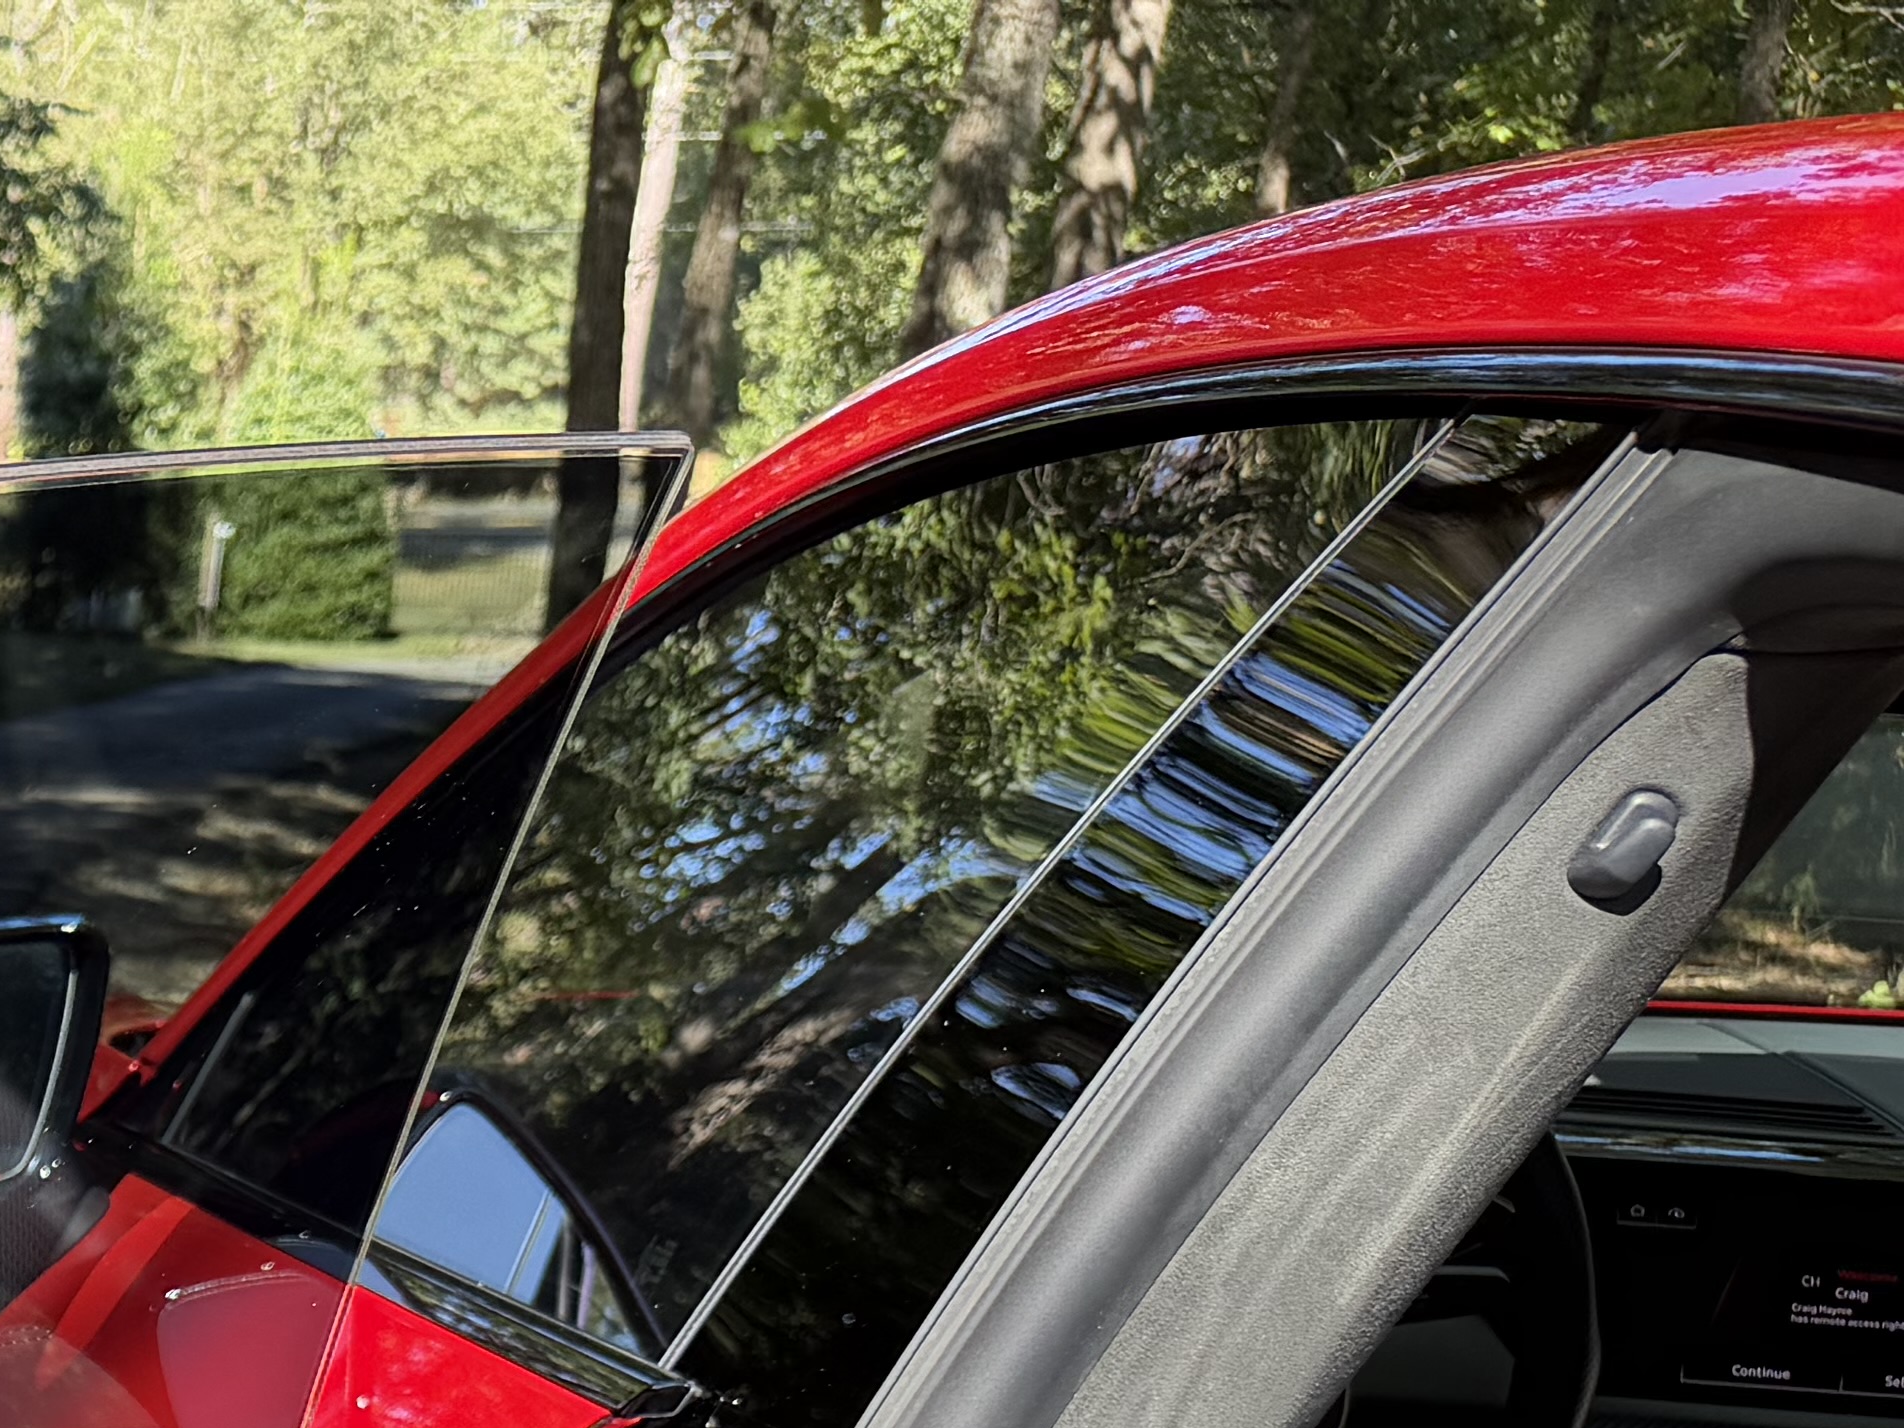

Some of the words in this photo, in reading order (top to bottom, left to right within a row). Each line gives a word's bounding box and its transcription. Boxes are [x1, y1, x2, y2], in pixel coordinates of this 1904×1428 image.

[1835, 1287, 1869, 1303] Craig
[1792, 1303, 1818, 1315] Craig
[1791, 1313, 1809, 1324] has
[1810, 1317, 1846, 1327] remote
[1848, 1320, 1881, 1330] access
[1732, 1364, 1791, 1380] Continue
